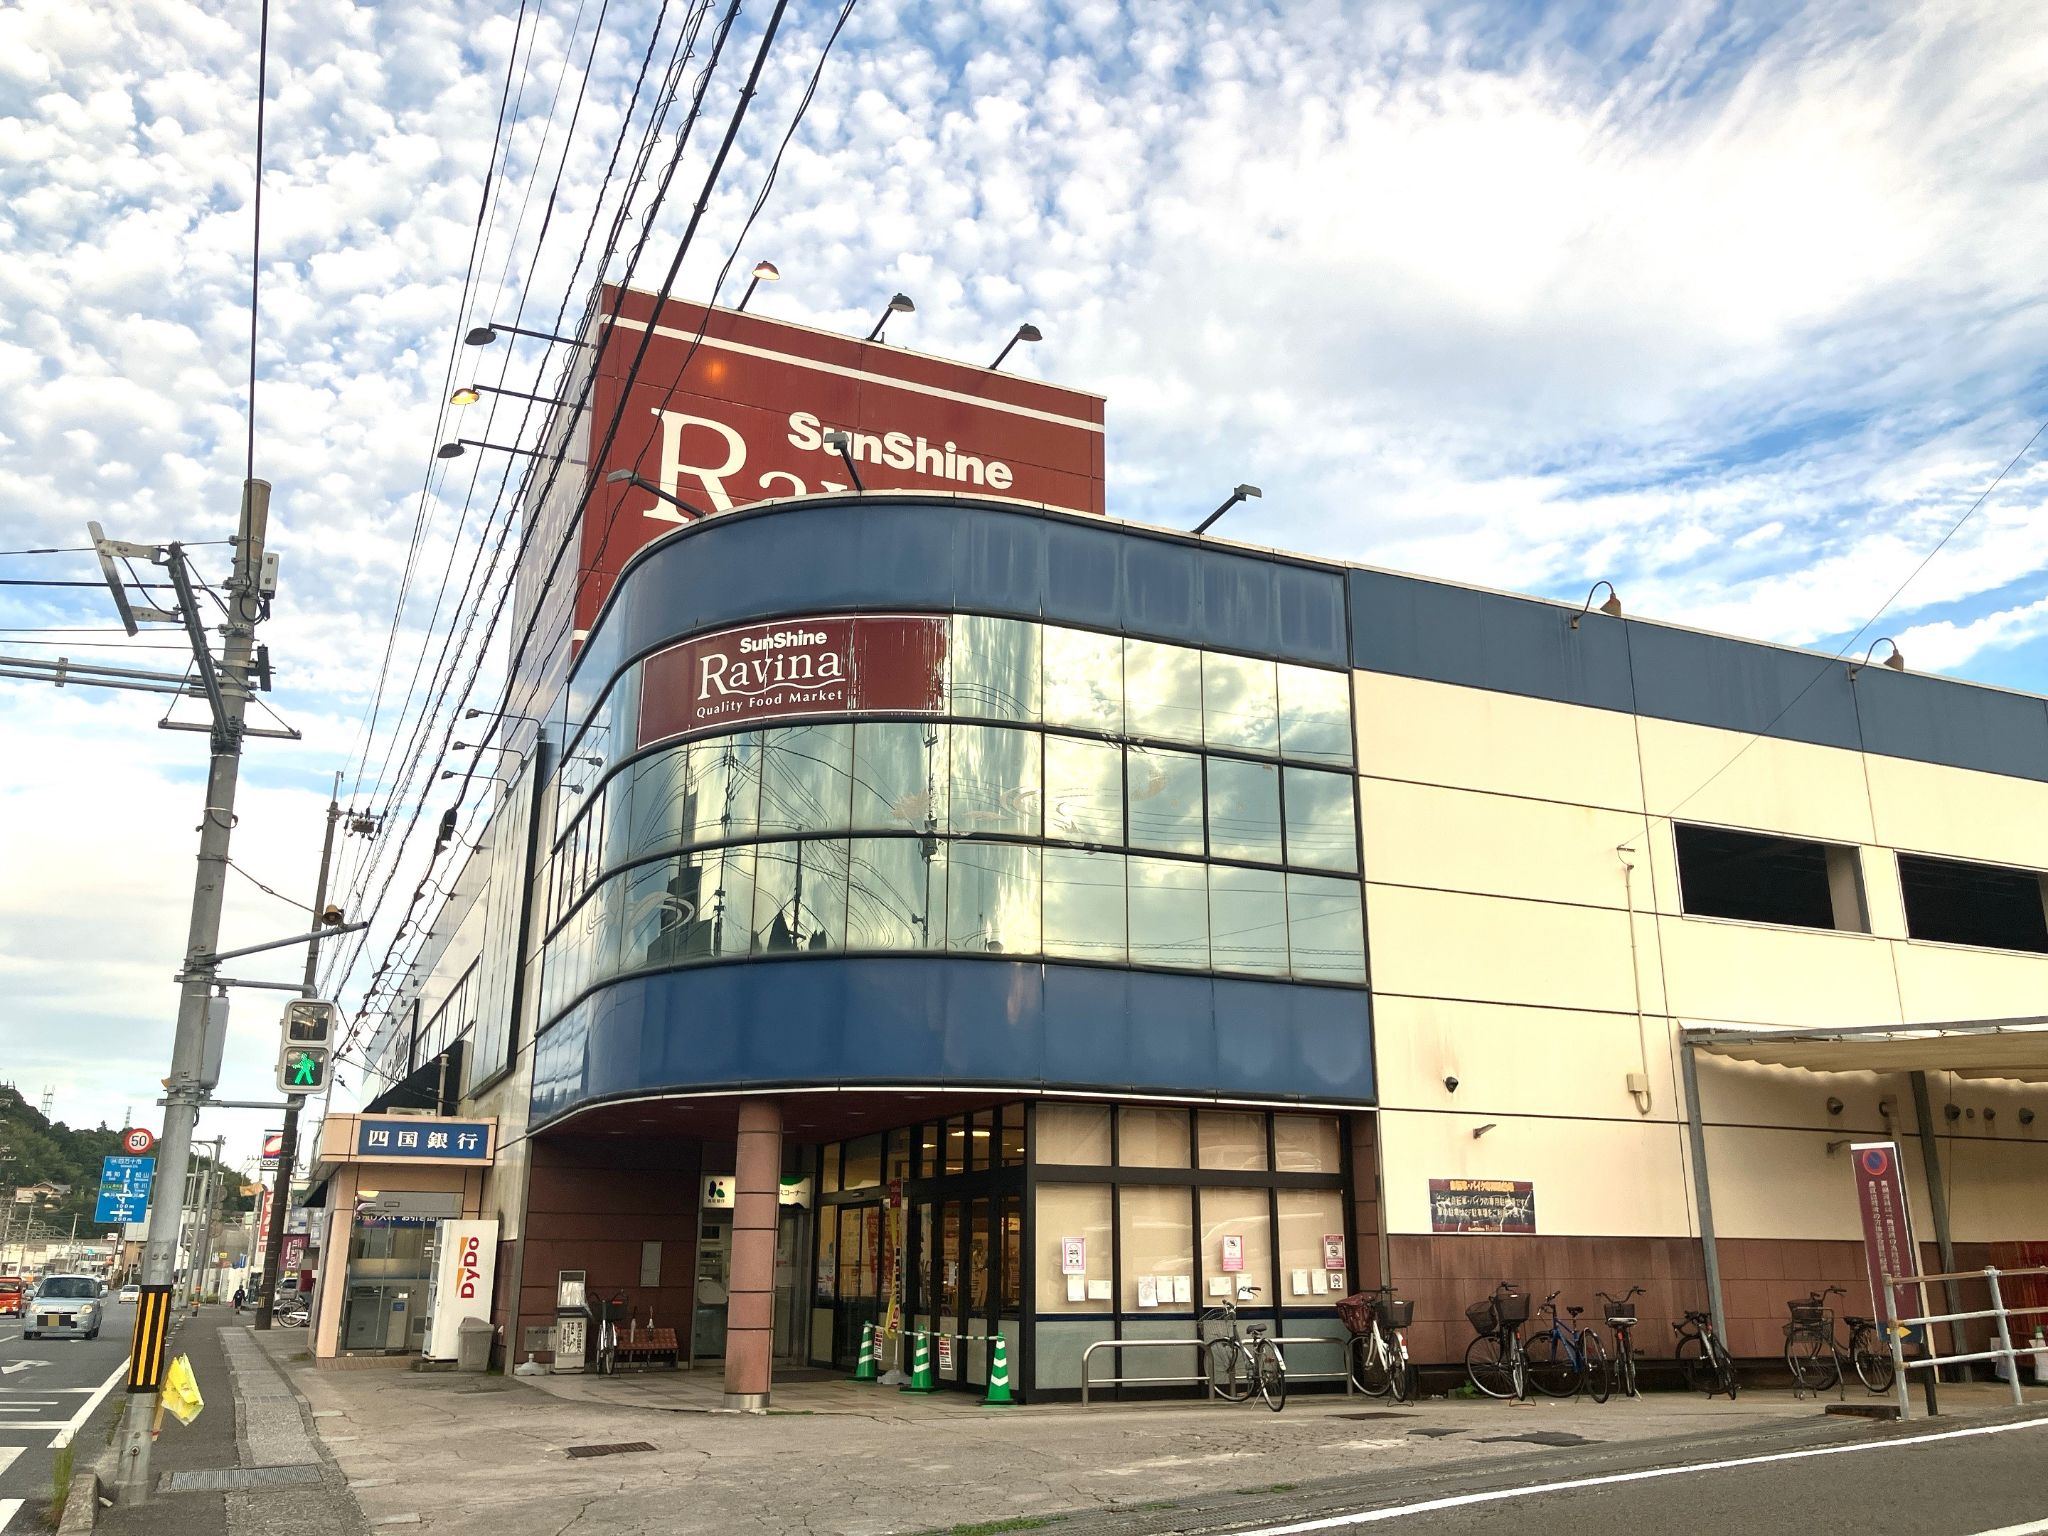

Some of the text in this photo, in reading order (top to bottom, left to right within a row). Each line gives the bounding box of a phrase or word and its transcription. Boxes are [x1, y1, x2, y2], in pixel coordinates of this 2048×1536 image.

[788, 411, 1014, 490] SunShine
[740, 629, 828, 655] SunShine
[697, 651, 844, 701] Ravina
[696, 690, 843, 719] Quality Food Market
[131, 1136, 146, 1146] 50
[368, 1130, 478, 1150] 四国銀行
[460, 1236, 480, 1299] DyDo
